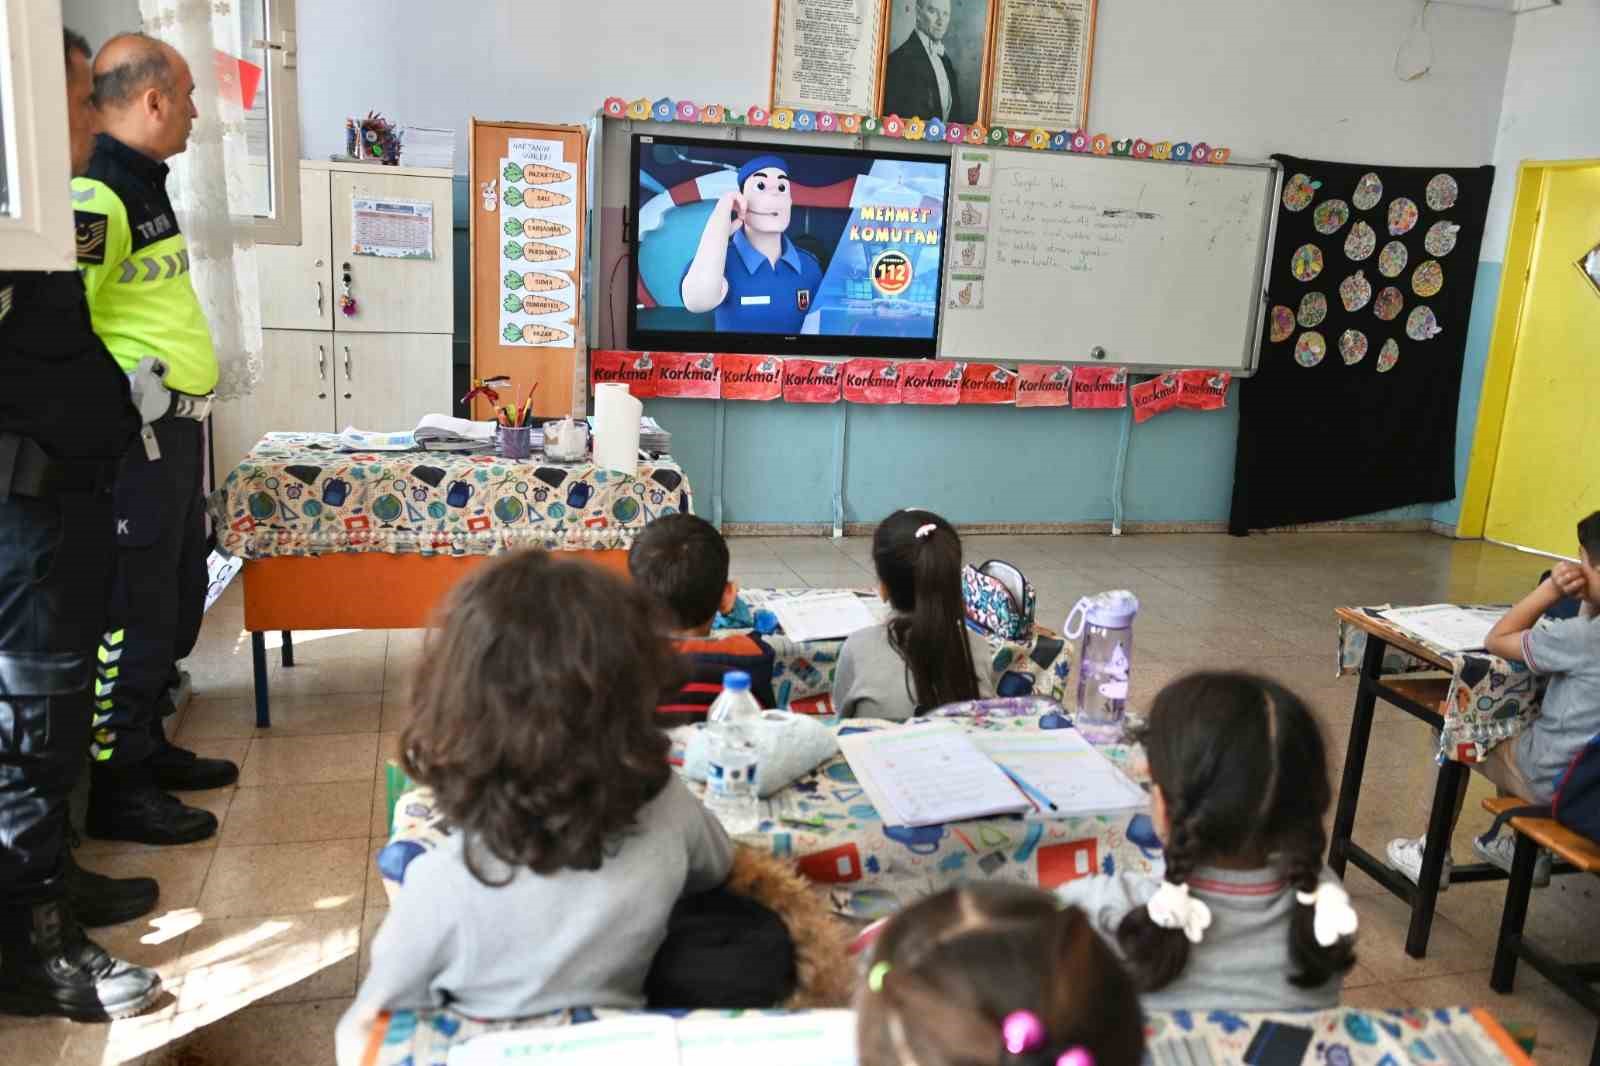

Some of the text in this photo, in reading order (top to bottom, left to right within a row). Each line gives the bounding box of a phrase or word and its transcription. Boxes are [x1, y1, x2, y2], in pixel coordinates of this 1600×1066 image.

[861, 206, 932, 224] MEHMET
[849, 223, 938, 246] KOMUTAN
[879, 263, 906, 281] 112
[594, 361, 653, 381] Korkma!
[660, 362, 718, 382] Korkma!
[723, 364, 780, 384] Korkma!
[785, 368, 840, 387] Korkma!
[847, 368, 900, 388] Korkma!
[905, 369, 959, 389] Korkma!
[962, 372, 1015, 391] Korkma!
[1019, 375, 1069, 392] Korkma!
